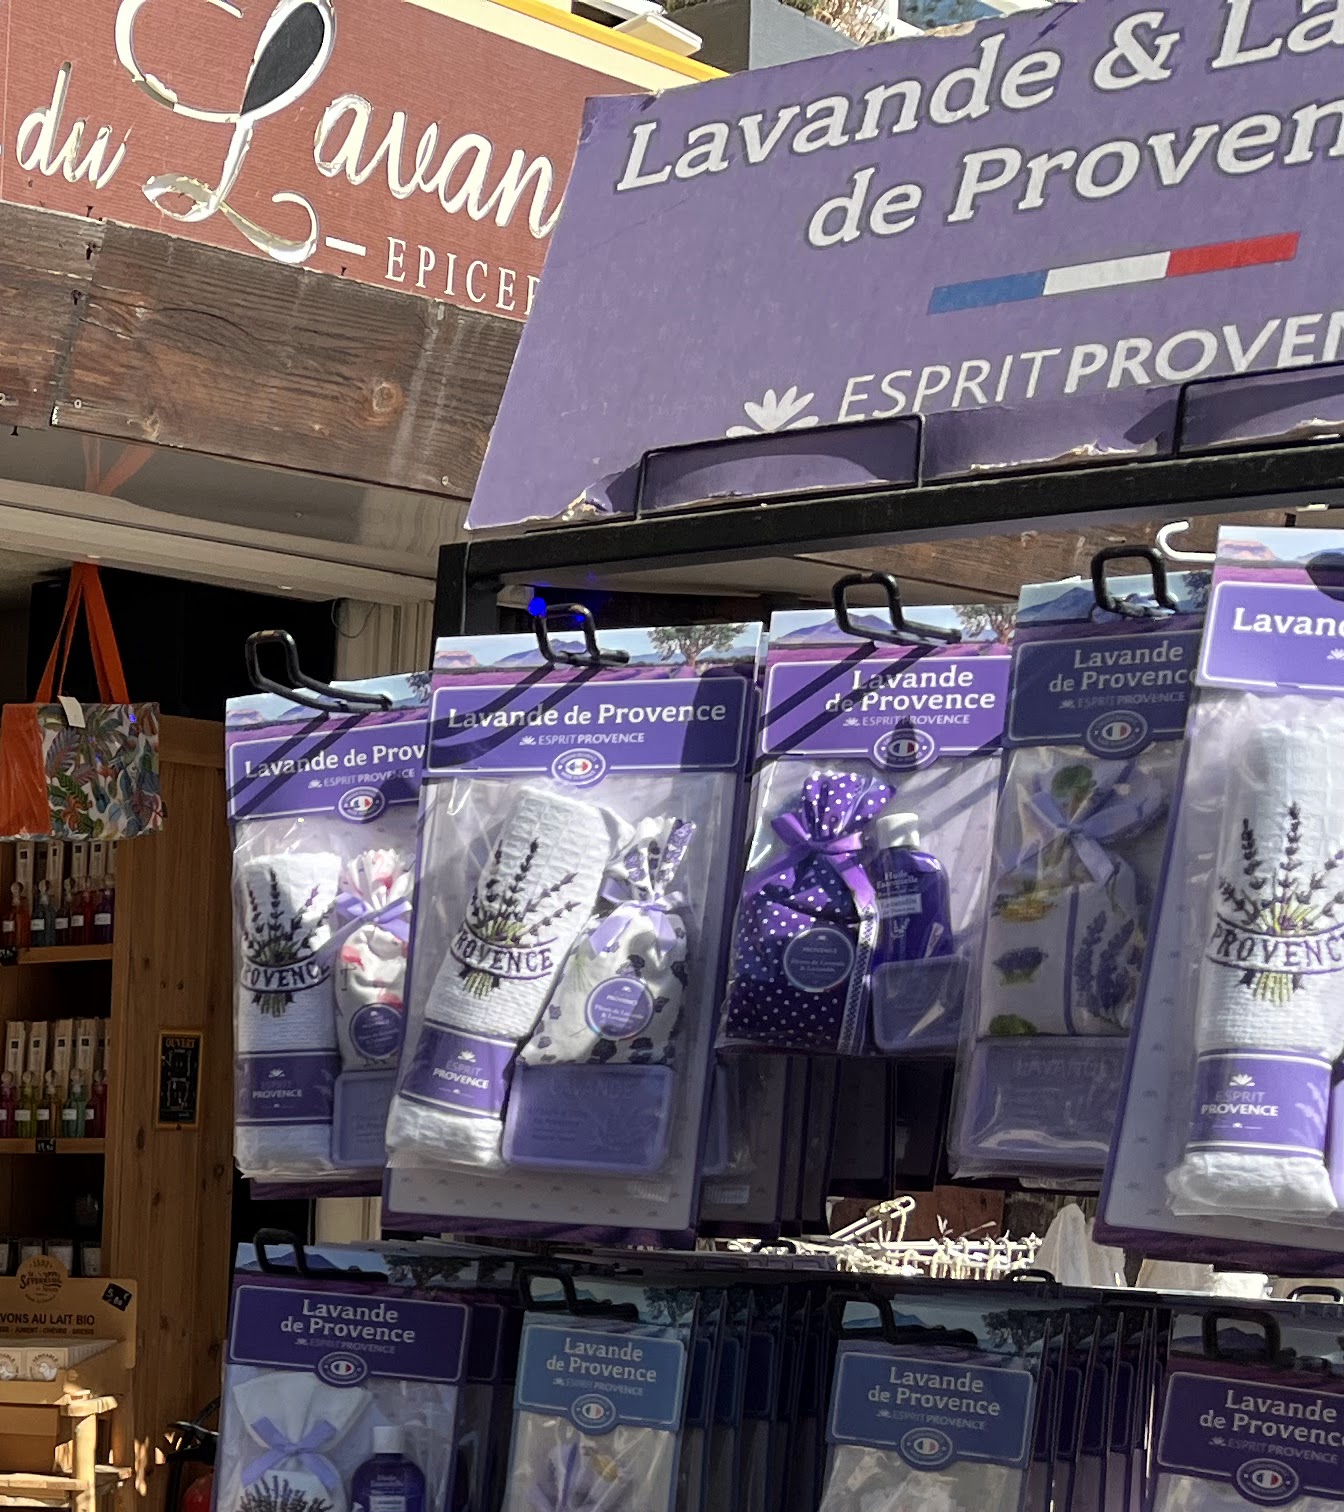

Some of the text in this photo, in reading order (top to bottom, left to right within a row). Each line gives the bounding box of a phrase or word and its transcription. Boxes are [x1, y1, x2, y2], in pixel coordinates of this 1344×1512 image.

[617, 32, 1063, 193] Lavande
[1094, 9, 1180, 91] &
[15, 62, 126, 190] du
[809, 168, 922, 249] de
[1074, 643, 1185, 670] Lavande
[853, 664, 974, 691] Lavande
[1049, 672, 1076, 693] de
[826, 689, 997, 712] de Provence
[448, 701, 727, 730] Lavande de Provence
[577, 731, 645, 745] PROVENCE
[244, 747, 339, 780] Lavande
[343, 748, 369, 767] de
[432, 1068, 490, 1089] PROVENCE
[252, 1088, 303, 1099] PROVENCE
[1201, 1103, 1279, 1117] PROVENCE
[32, 1313, 47, 1325] AU
[49, 1314, 73, 1326] LAIT
[76, 1315, 95, 1326] BIO
[302, 1298, 399, 1324] Lavande
[281, 1316, 416, 1344] de Provence
[564, 1337, 643, 1362] Lavande
[547, 1354, 657, 1383] de Provence
[890, 1366, 984, 1394] Lavande
[868, 1384, 1001, 1417] de Provence
[1225, 1389, 1338, 1422] Lavande
[1200, 1409, 1227, 1431] de
[1265, 1443, 1339, 1465] PROVENCE
